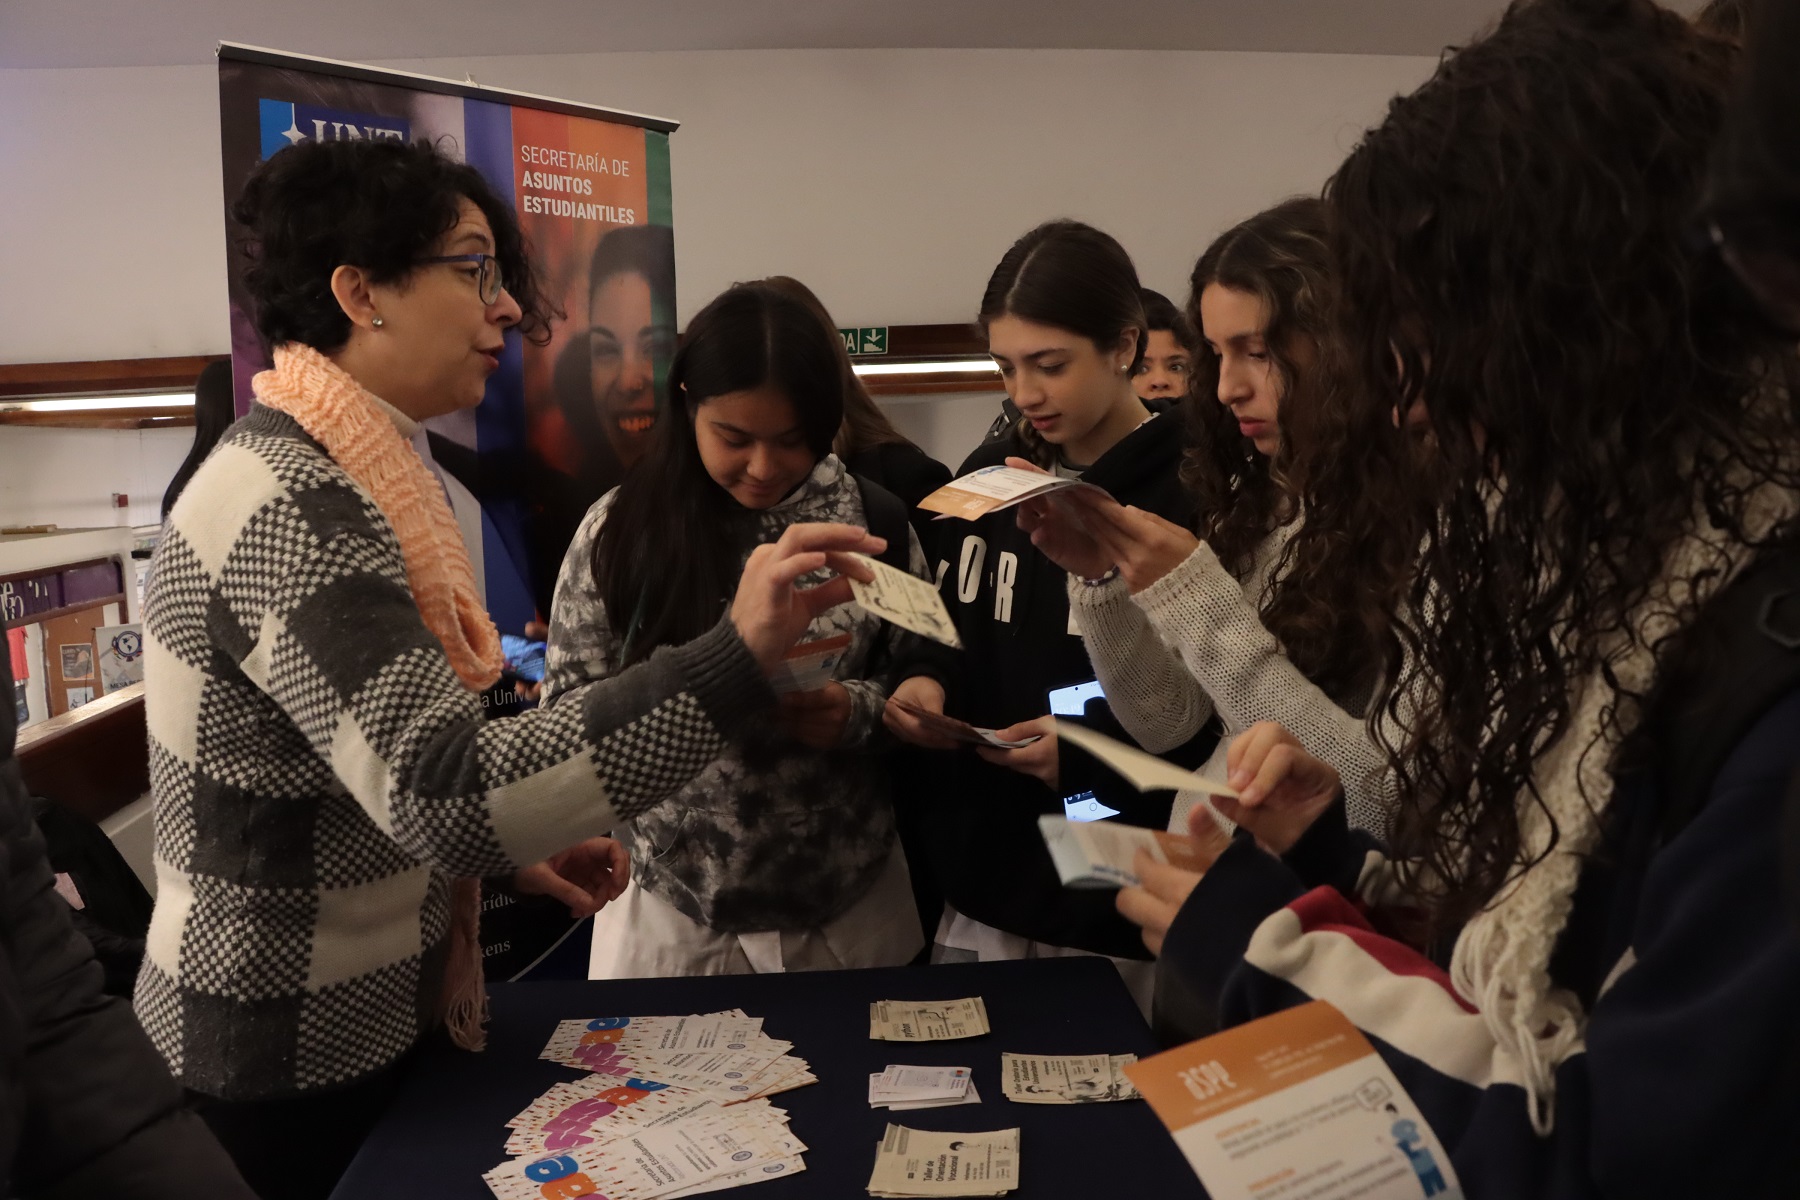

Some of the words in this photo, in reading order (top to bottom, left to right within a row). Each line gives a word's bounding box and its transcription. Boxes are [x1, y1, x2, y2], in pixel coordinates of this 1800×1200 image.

[521, 145, 609, 174] SECRETARÍA
[612, 159, 630, 177] DE
[522, 170, 593, 196] ASUNTOS
[523, 195, 635, 225] ESTUDIANTILES
[923, 1167, 934, 1181] Taller
[935, 1154, 947, 1181] Orientación
[947, 1155, 959, 1181] Vocacional
